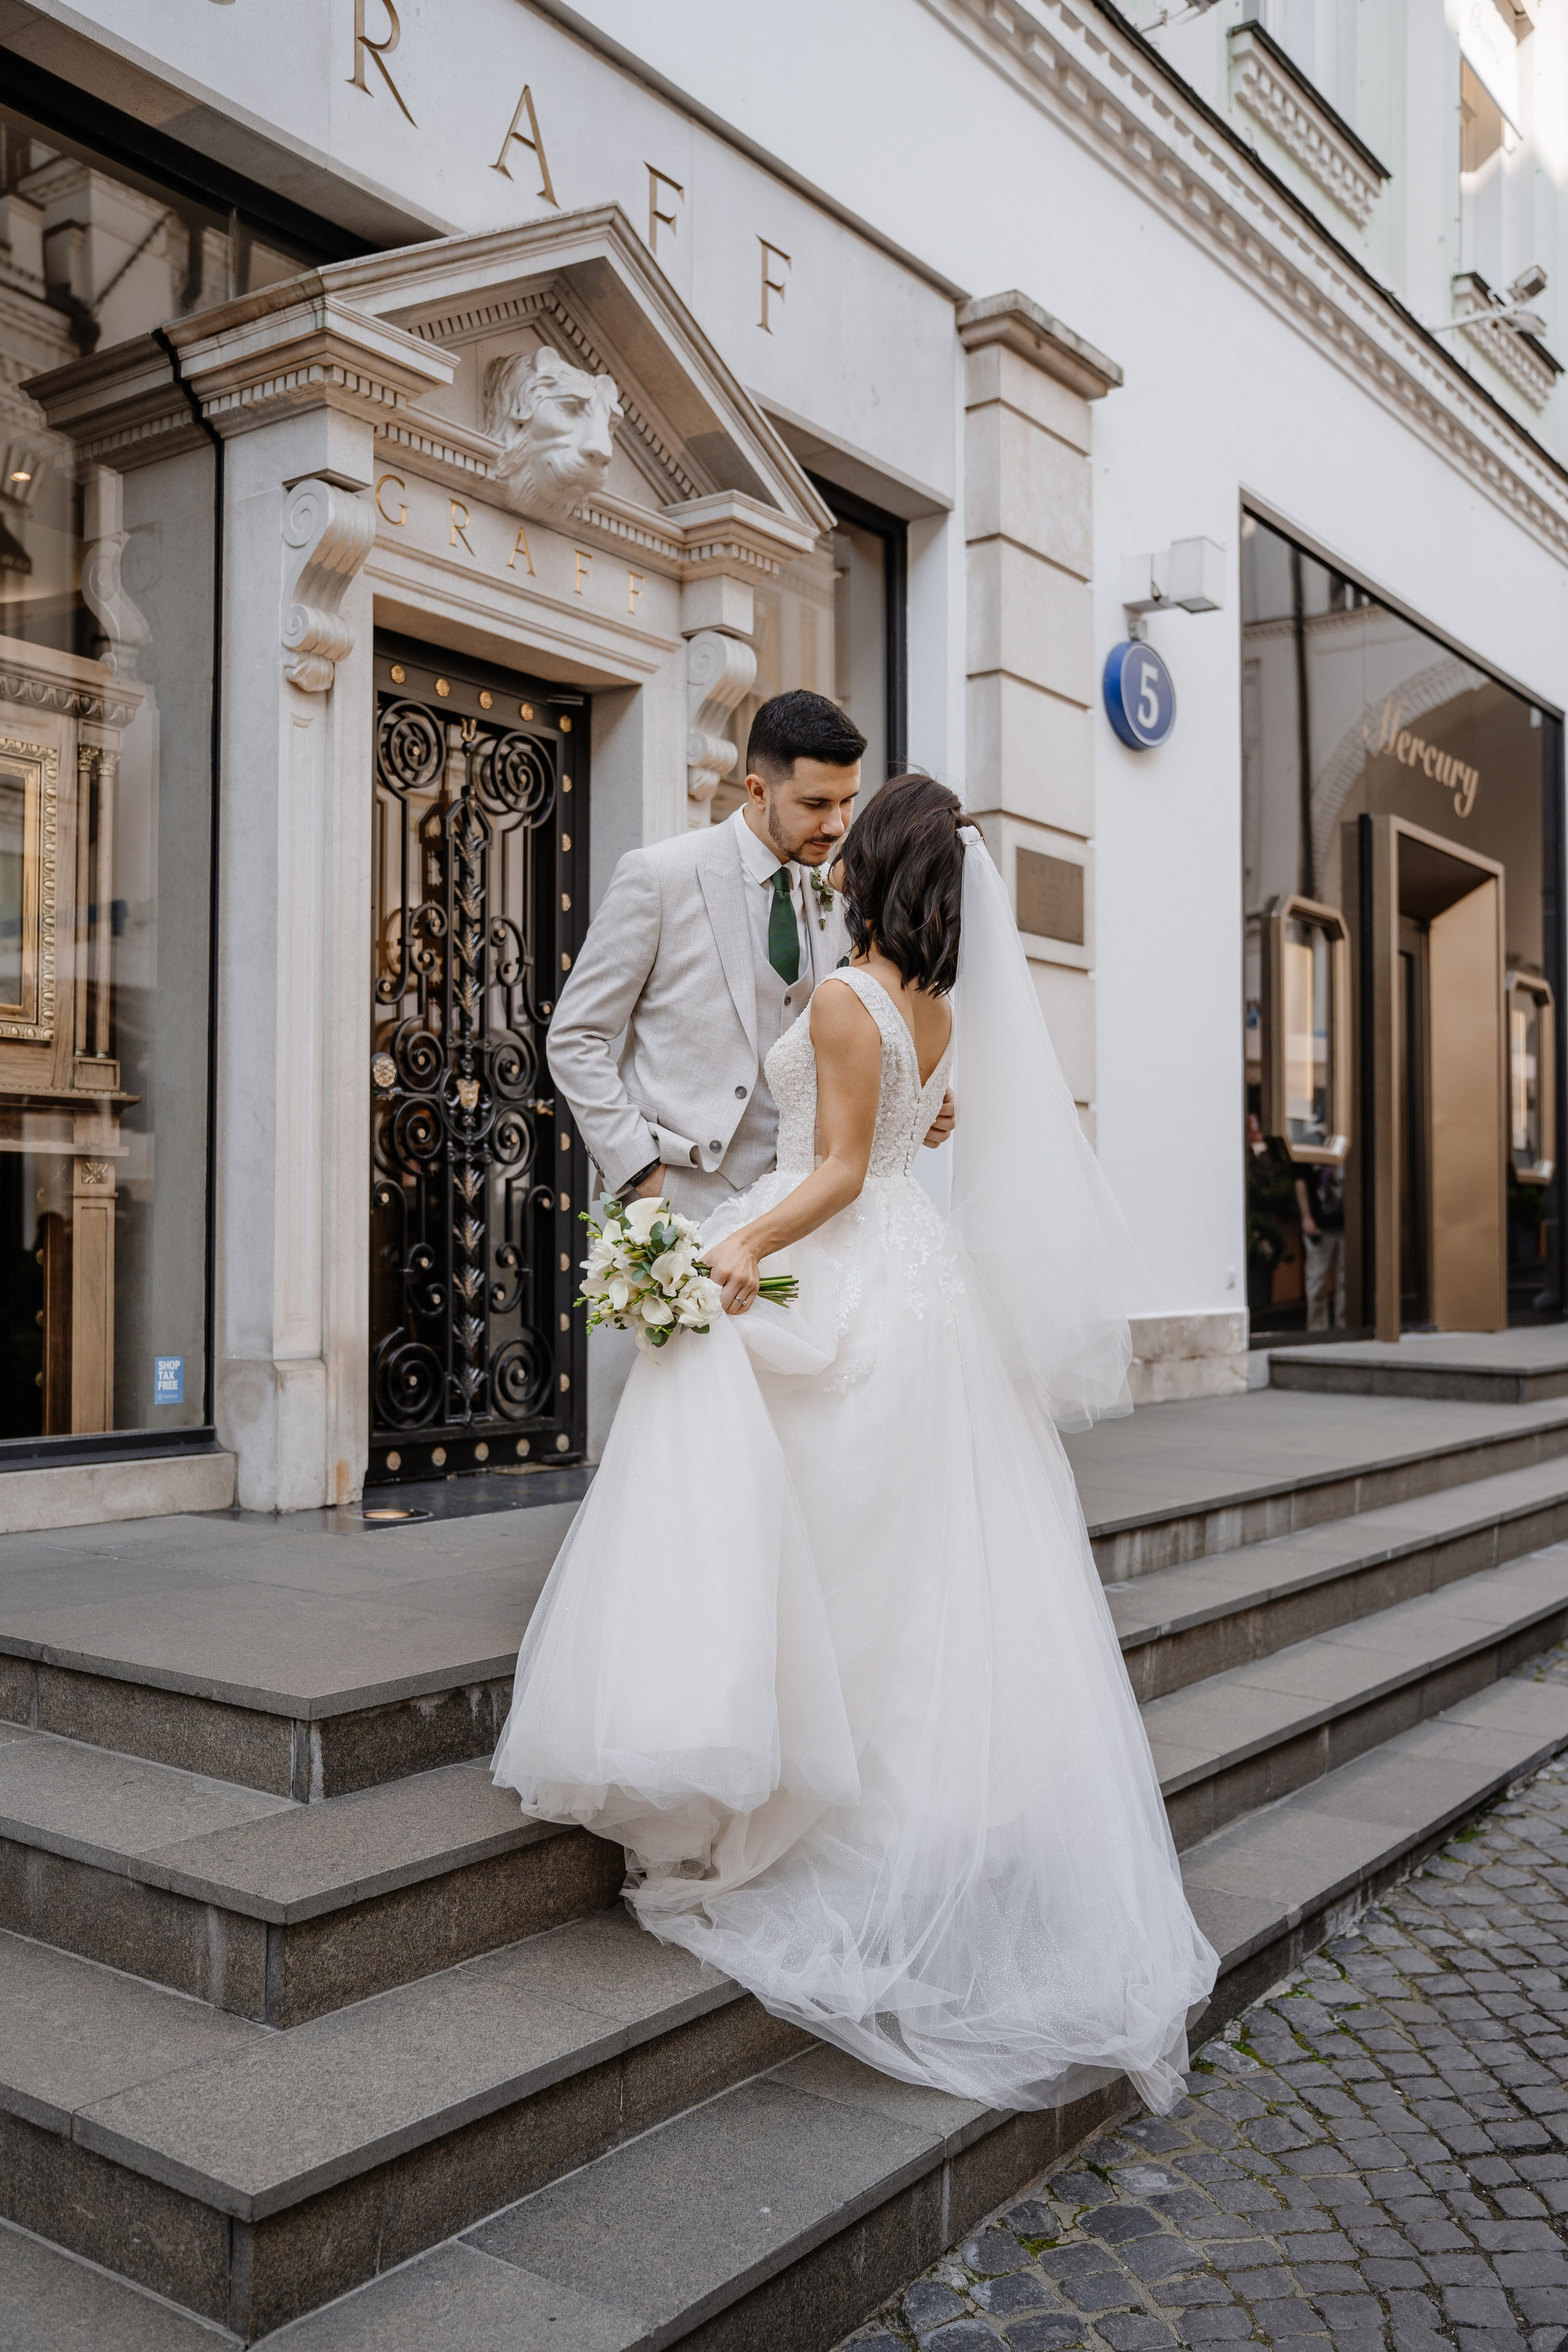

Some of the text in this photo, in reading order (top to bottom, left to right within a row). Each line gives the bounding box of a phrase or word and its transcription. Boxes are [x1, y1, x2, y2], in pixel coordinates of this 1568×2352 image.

[207, 0, 791, 335] RAFF
[375, 475, 646, 614] GRAFF
[1137, 661, 1159, 729] 5
[1362, 695, 1479, 818] Mercury
[157, 1380, 178, 1390] FREE
[158, 1360, 181, 1371] SHOP
[158, 1371, 175, 1380] TAX
